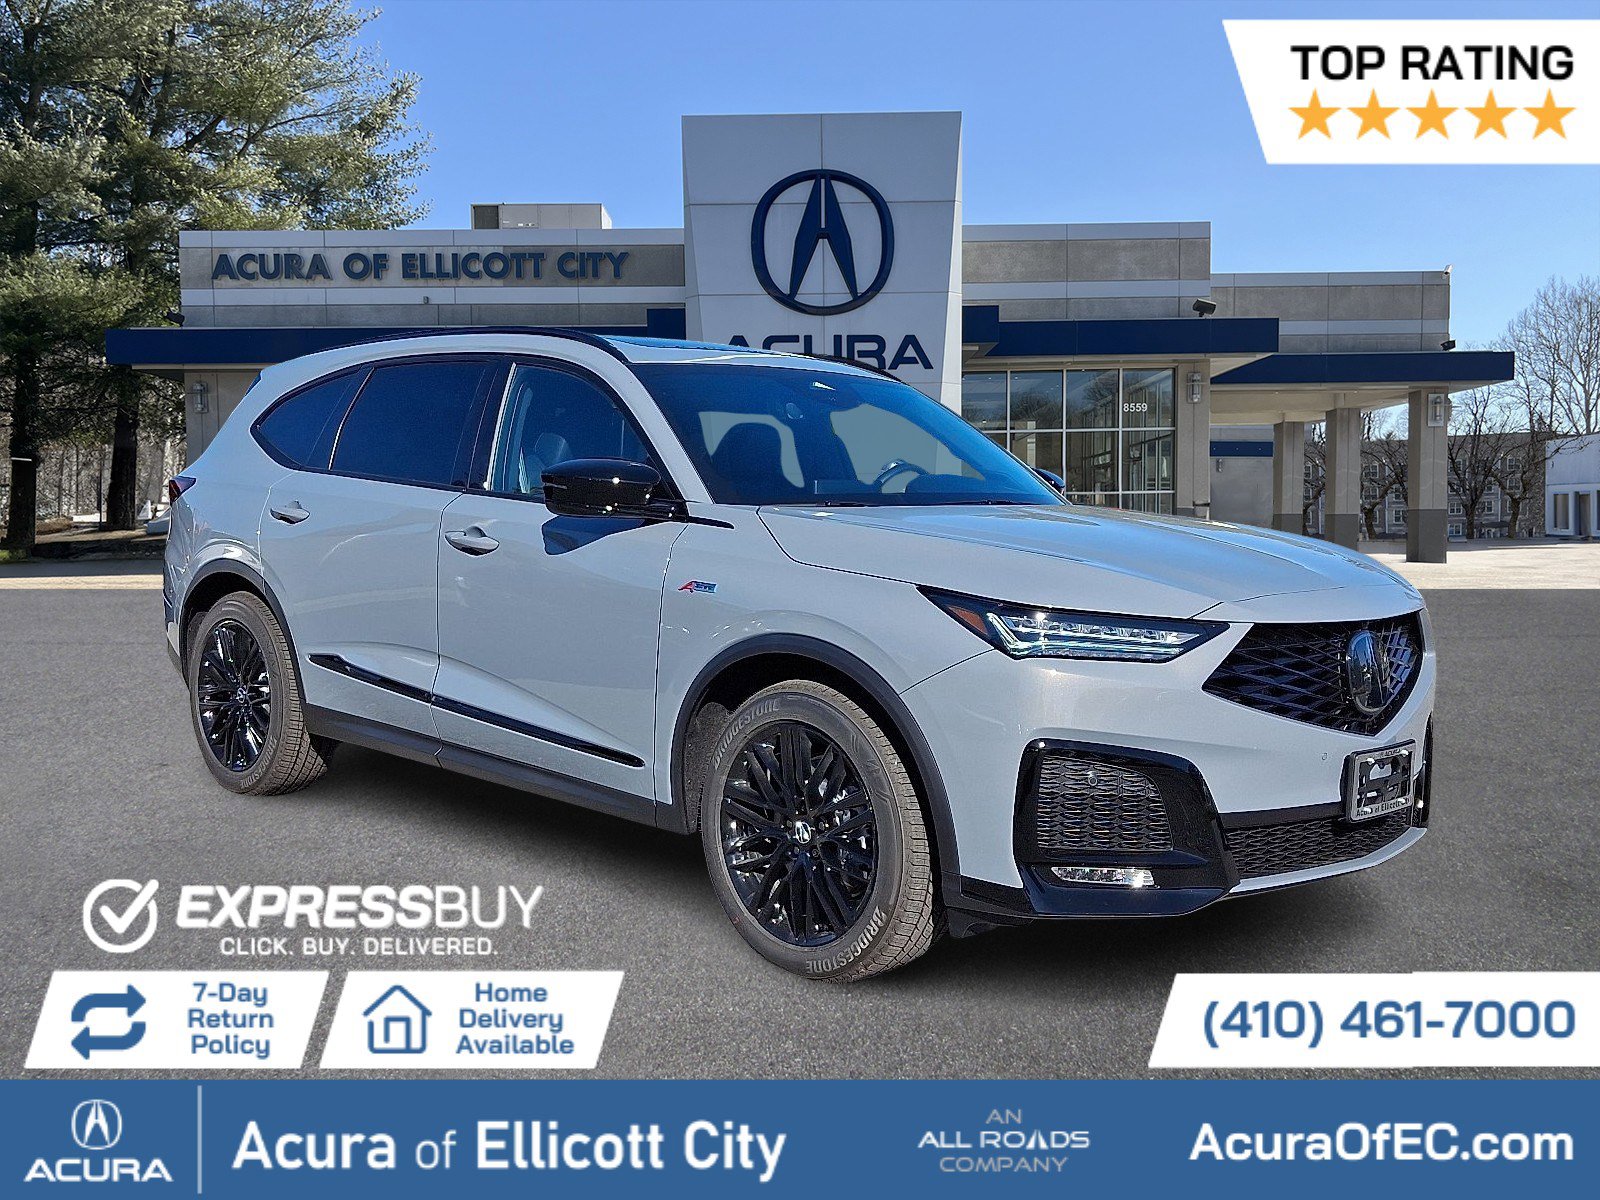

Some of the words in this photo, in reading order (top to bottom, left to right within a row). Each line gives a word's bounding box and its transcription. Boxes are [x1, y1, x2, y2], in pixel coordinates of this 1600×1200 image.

[211, 253, 332, 280] ACURA
[343, 253, 390, 279] OF
[401, 252, 546, 279] ELLICOTT
[557, 252, 629, 279] CITY
[728, 334, 934, 370] URA
[1123, 402, 1148, 412] 8559
[1356, 807, 1373, 817] Acu
[805, 905, 888, 973] BRIDGESTONE
